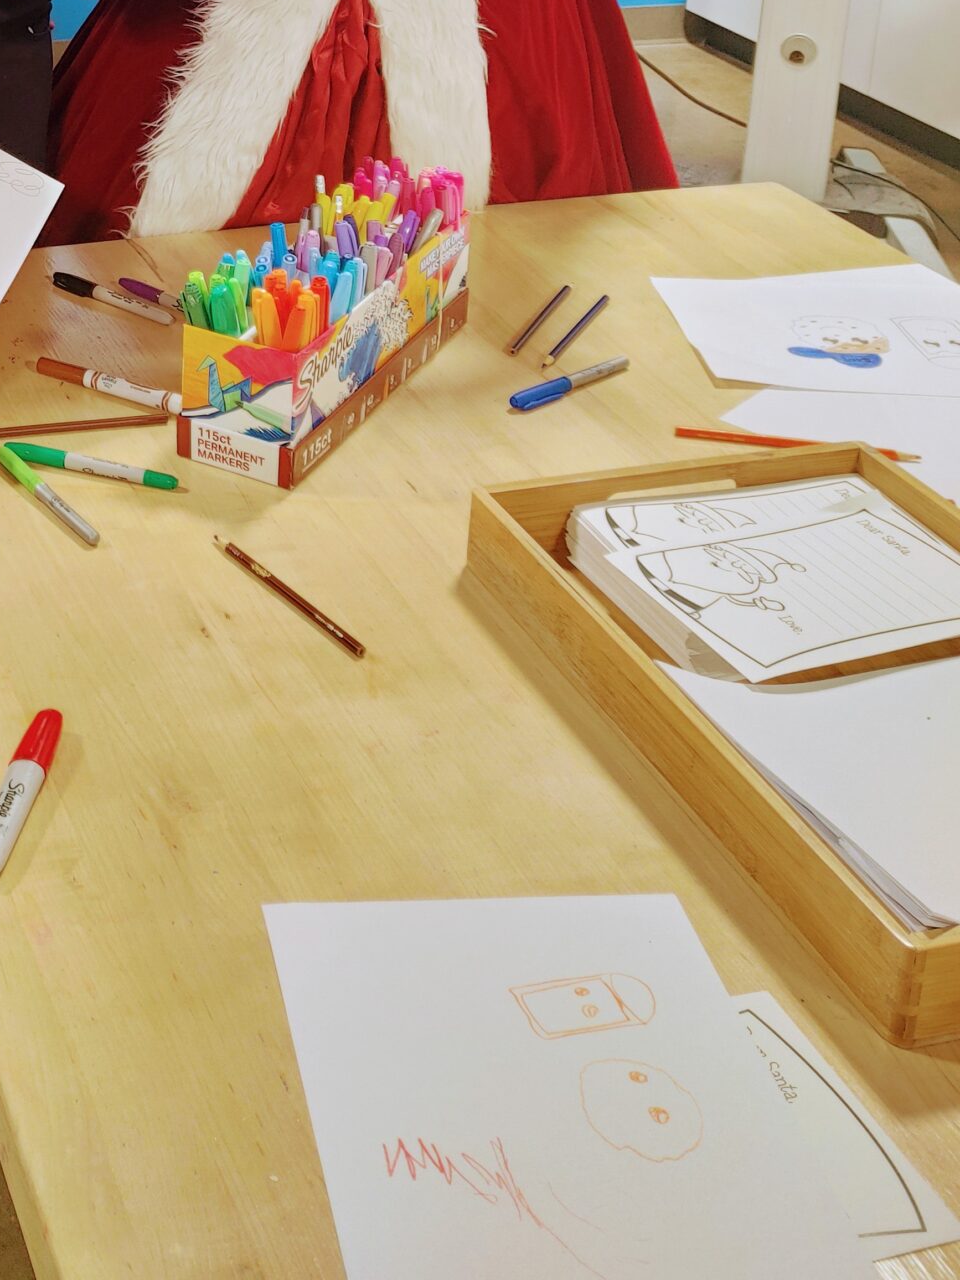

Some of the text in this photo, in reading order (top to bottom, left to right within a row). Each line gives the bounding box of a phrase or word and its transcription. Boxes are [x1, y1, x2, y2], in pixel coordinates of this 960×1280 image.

[293, 324, 354, 411] Sharpie
[198, 427, 232, 445] 115ct
[301, 428, 332, 466] 115ct
[197, 438, 265, 467] PERMANENT
[197, 448, 251, 472] MARKERS
